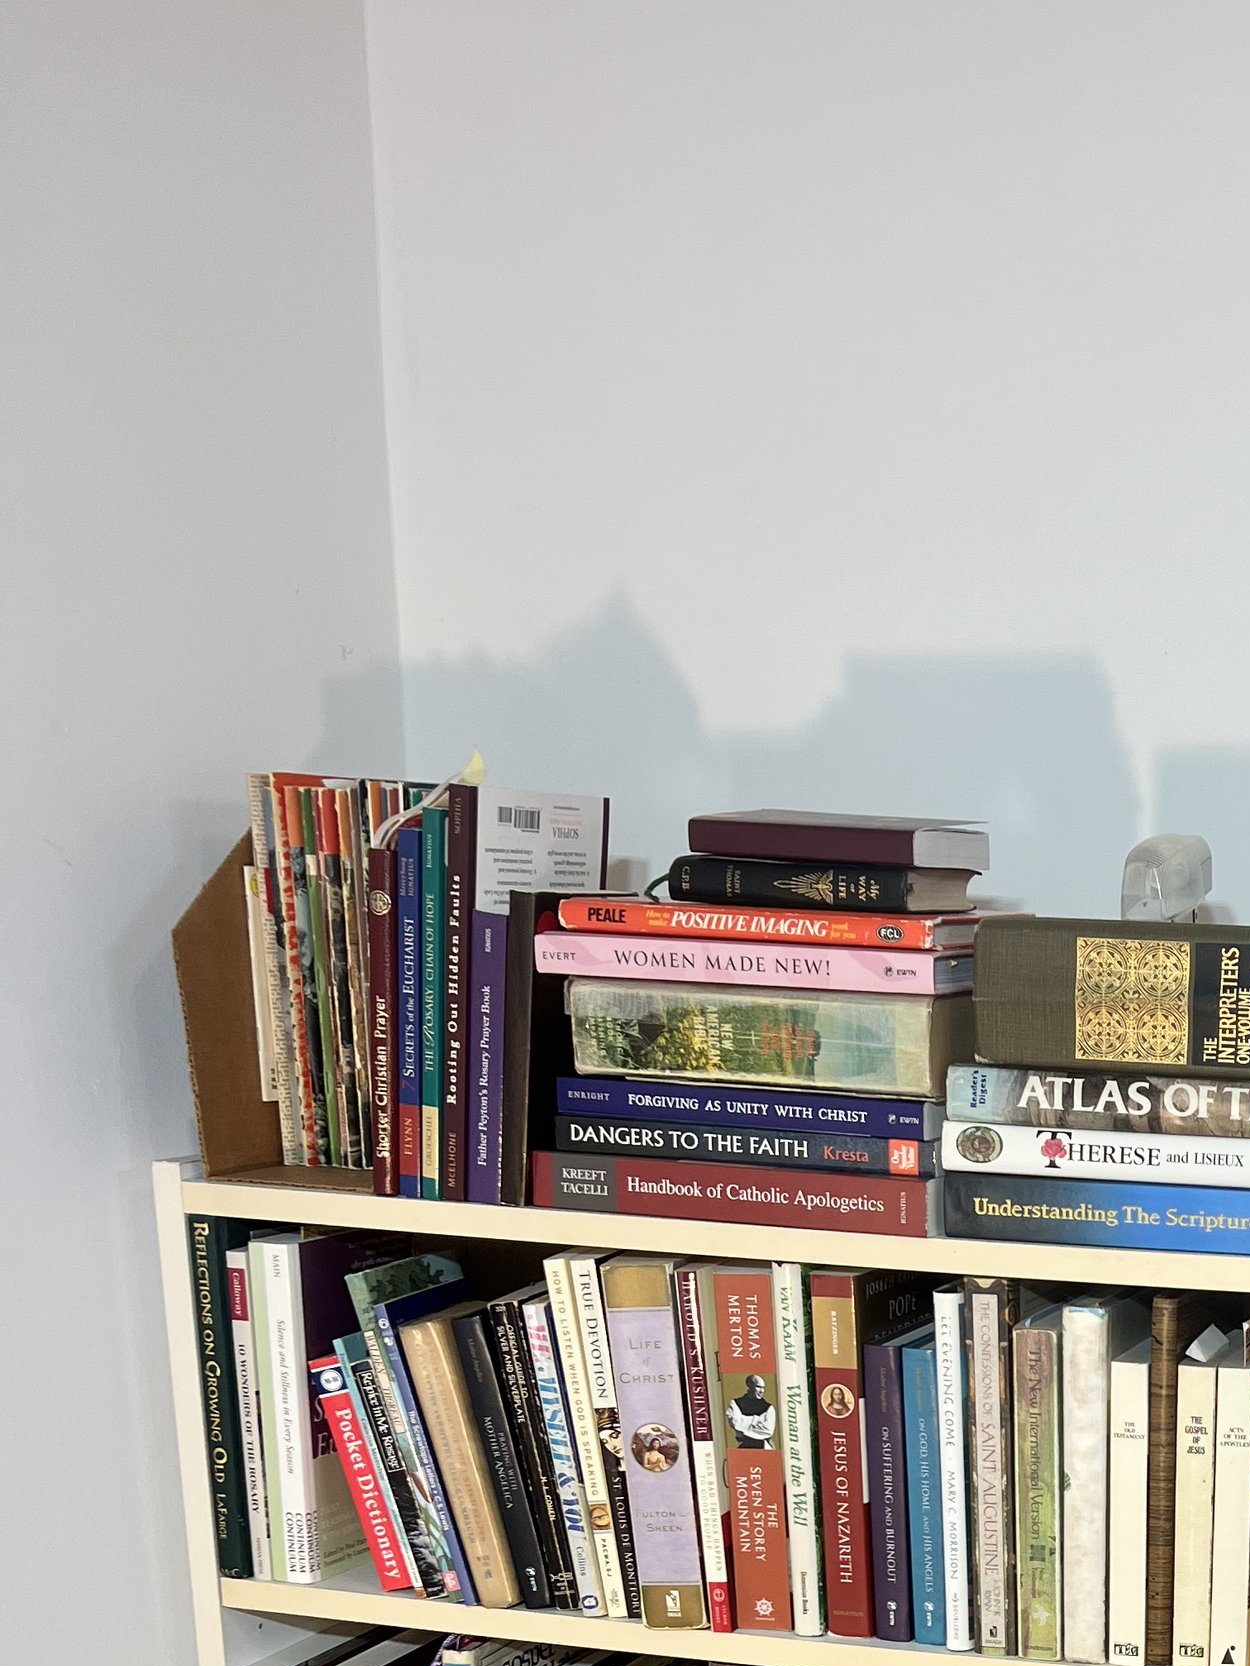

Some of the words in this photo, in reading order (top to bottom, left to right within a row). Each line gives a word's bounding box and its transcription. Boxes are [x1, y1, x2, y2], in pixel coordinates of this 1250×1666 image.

[454, 797, 462, 834] SOPHIA
[450, 875, 460, 927] Faults
[587, 907, 626, 924] PEALE
[671, 910, 749, 932] POSITIVE
[749, 916, 829, 937] IMAGING
[449, 935, 459, 995] Hidden
[542, 951, 576, 961] EVERT
[614, 949, 695, 969] WOMEN
[704, 955, 766, 972] MADE
[774, 958, 831, 976] NEW!
[896, 968, 917, 977] EWTN
[374, 996, 389, 1038] Prayer
[482, 985, 490, 1014] Book
[1218, 946, 1240, 1064] INTERPRETER'S
[447, 1004, 458, 1033] Out
[481, 1018, 490, 1049] Prayer
[375, 1046, 388, 1106] Christian
[447, 1040, 460, 1104] Rooting
[480, 1052, 490, 1087] Rosary
[567, 1090, 610, 1101] ENRIGHT
[627, 1094, 699, 1111] FORGIVING
[704, 1100, 721, 1111] AS
[727, 1101, 769, 1116] UNITY
[774, 1105, 813, 1119] WITH
[818, 1108, 868, 1123] CHRIST
[970, 1070, 980, 1110] Reader's
[978, 1074, 988, 1106] Digest
[1016, 1075, 1151, 1116] ATLAS
[1164, 1083, 1221, 1121] OF
[479, 1093, 490, 1131] Peyton's
[376, 1110, 389, 1158] Shorter
[404, 1118, 413, 1155] FLYNN
[477, 1136, 486, 1166] Father
[569, 1124, 664, 1148] DANGERS
[668, 1134, 698, 1150] TO
[703, 1134, 744, 1153] THE
[749, 1137, 808, 1158] FAITH
[823, 1145, 869, 1163] Kresta
[561, 1181, 608, 1196] TACELLI
[562, 1168, 607, 1182] KREEFT
[627, 1176, 702, 1198] Handbook
[707, 1183, 723, 1200] of
[726, 1184, 790, 1205] Catholic
[793, 1189, 884, 1213] Apologetics
[973, 1198, 1120, 1228] Understanding
[1124, 1206, 1161, 1226] The
[192, 1222, 213, 1325] REFLECTIONS
[272, 1254, 281, 1278] MAIN
[232, 1272, 241, 1317] Calloway
[579, 1270, 594, 1311] TRUE
[203, 1330, 215, 1355] ON
[629, 1339, 662, 1350] LIFE
[727, 1295, 743, 1358] MERTON
[745, 1294, 761, 1360] THOMAS
[586, 1318, 608, 1398] DEVOTION
[620, 1372, 674, 1384] CHRIST
[205, 1361, 222, 1442] GROWING
[213, 1447, 228, 1483] OLD
[831, 1431, 848, 1473] JESUS
[981, 1423, 997, 1473] SAINT
[335, 1408, 367, 1470] Pocket
[357, 1473, 401, 1579] Dictionary
[750, 1466, 763, 1507] SEVEN
[835, 1478, 849, 1497] OF
[735, 1476, 751, 1553] MOUNTAIN
[767, 1503, 779, 1528] THE
[983, 1478, 999, 1576] AUGUSTINE
[753, 1512, 766, 1562] STOREY
[836, 1501, 853, 1583] NAZARETH
